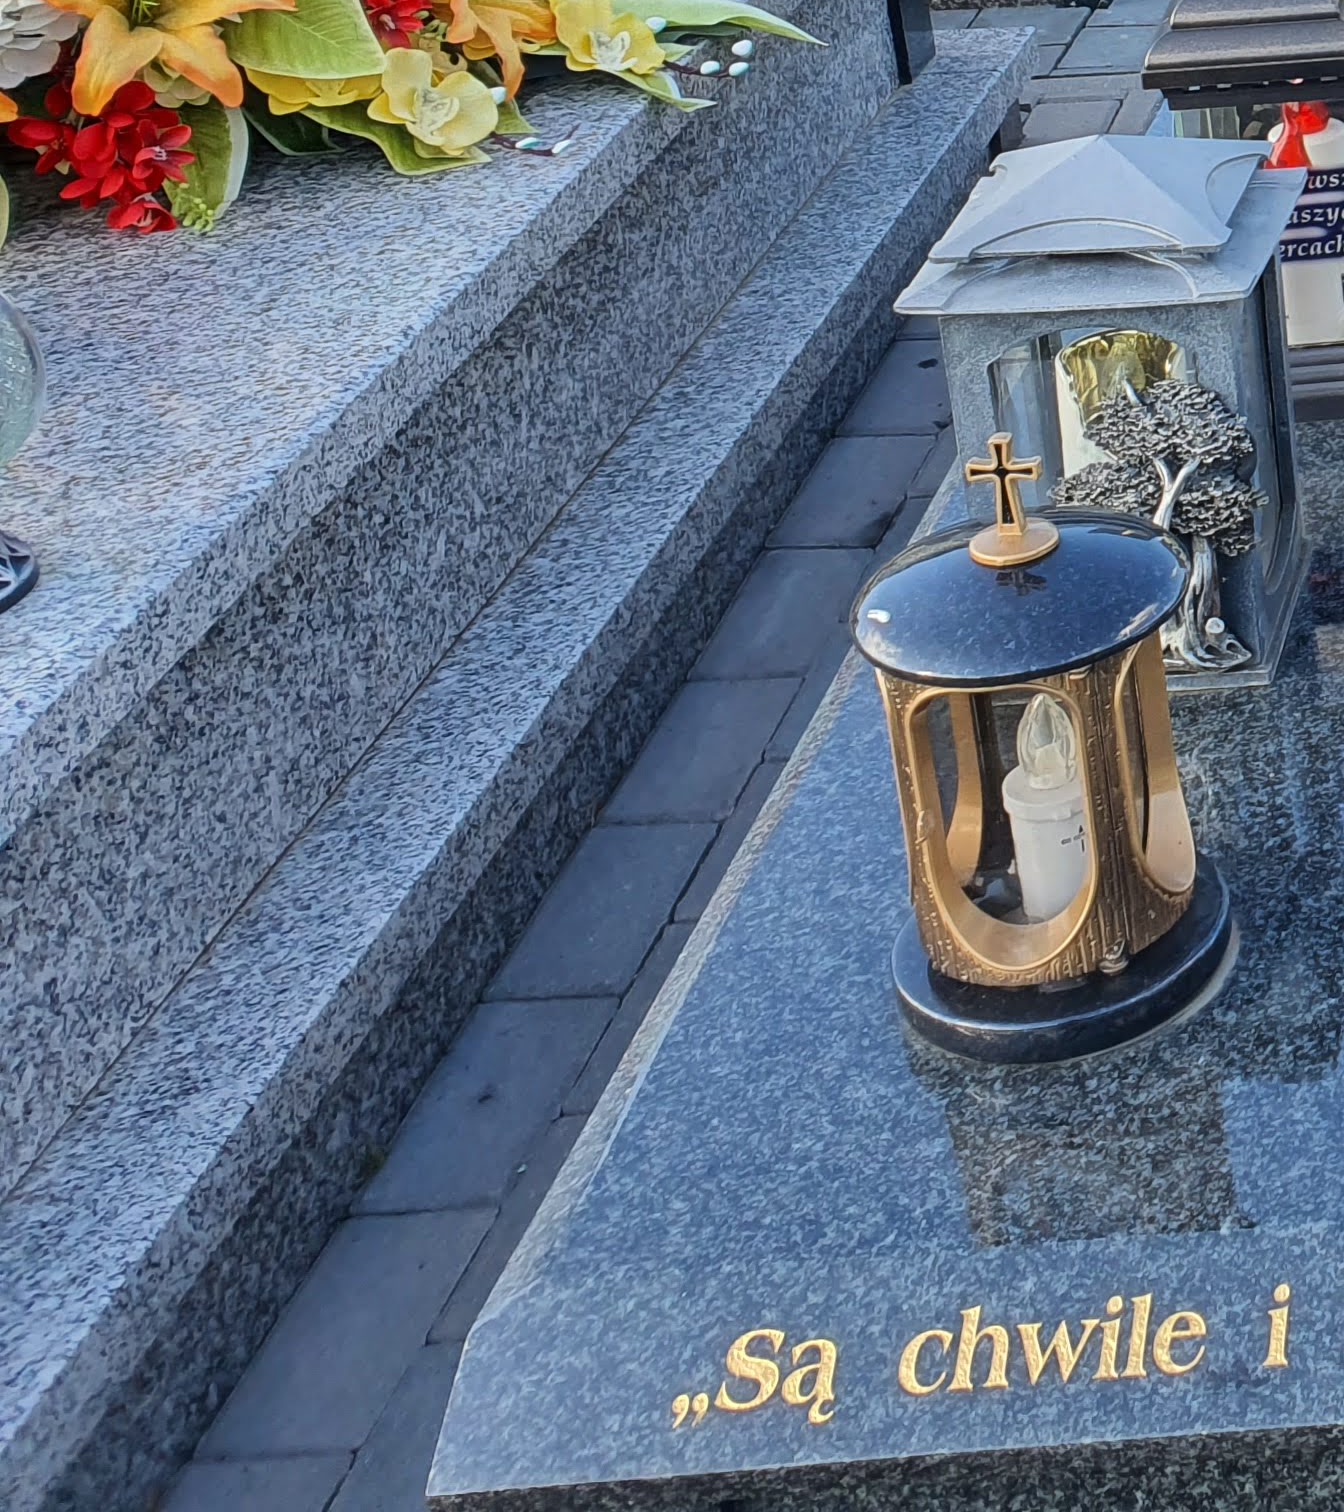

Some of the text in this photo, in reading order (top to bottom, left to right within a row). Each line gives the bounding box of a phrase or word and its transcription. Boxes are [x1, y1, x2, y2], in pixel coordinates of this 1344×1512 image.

[671, 1326, 839, 1429] „Są
[899, 1292, 1207, 1397] chwile
[1262, 1283, 1292, 1368] i
